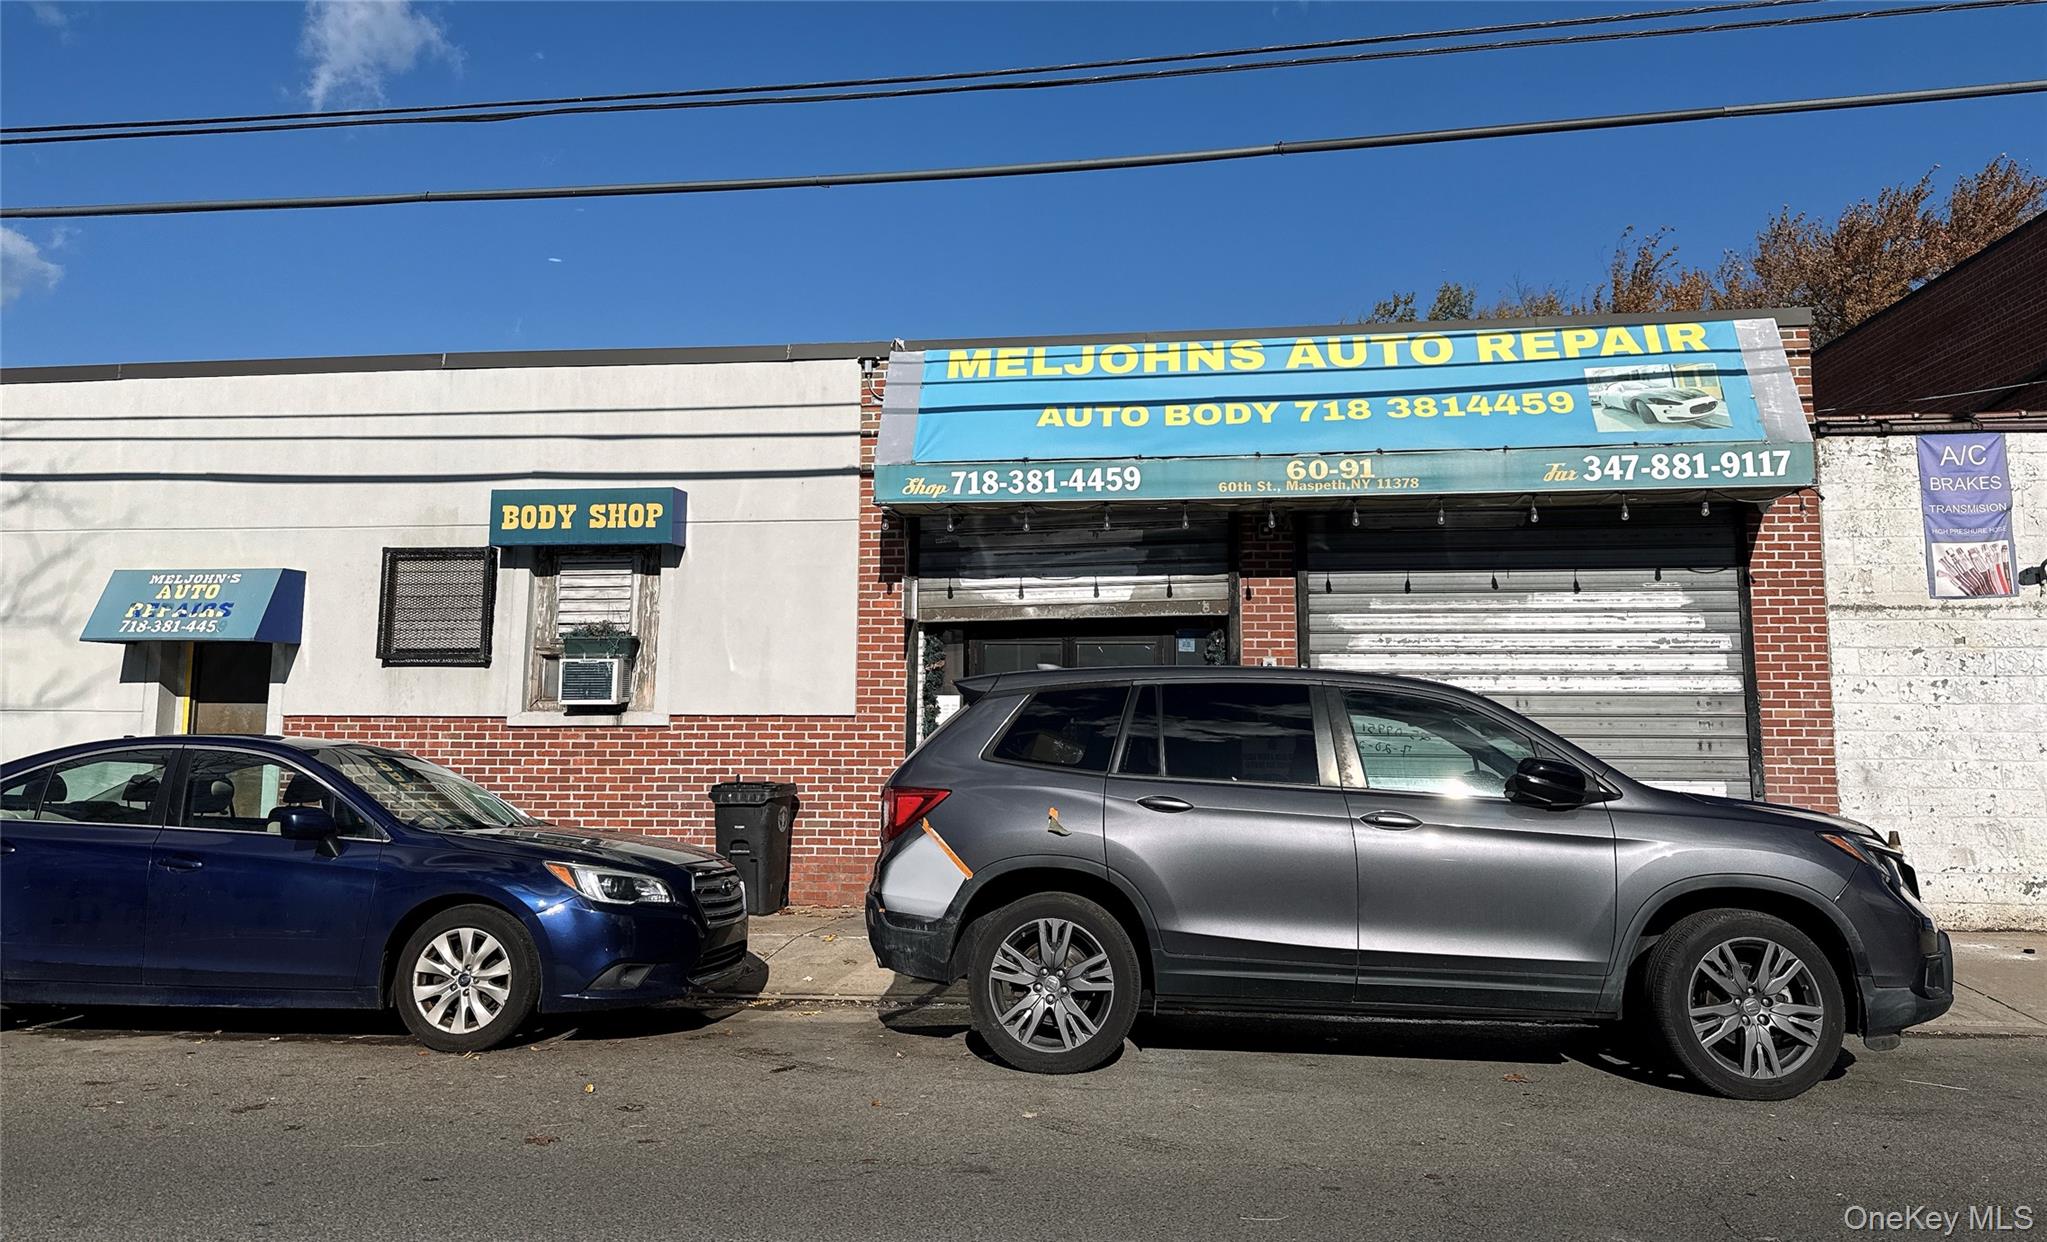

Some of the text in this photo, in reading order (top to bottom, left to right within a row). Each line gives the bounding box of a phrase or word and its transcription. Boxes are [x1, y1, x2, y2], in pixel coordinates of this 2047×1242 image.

[946, 322, 1711, 380] MELJOHNS AUTO REPAIR
[1036, 390, 1575, 428] AUTO BODY 718 3814459
[1542, 450, 1792, 482] Fax 347-881-9117
[1939, 444, 1987, 466] A/C
[1285, 458, 1376, 480] 60-91
[901, 466, 1142, 498] Shop 718-381-4459
[1217, 481, 1252, 493] 60th
[1376, 477, 1420, 489] 11378
[1929, 476, 2002, 491] BRAKES
[501, 502, 664, 530] BODY SHOP
[1928, 502, 2008, 514] TRANSMISION
[148, 573, 243, 585] MELJOHN'S
[155, 584, 222, 600] AUTO
[124, 602, 235, 619] REPAIRS
